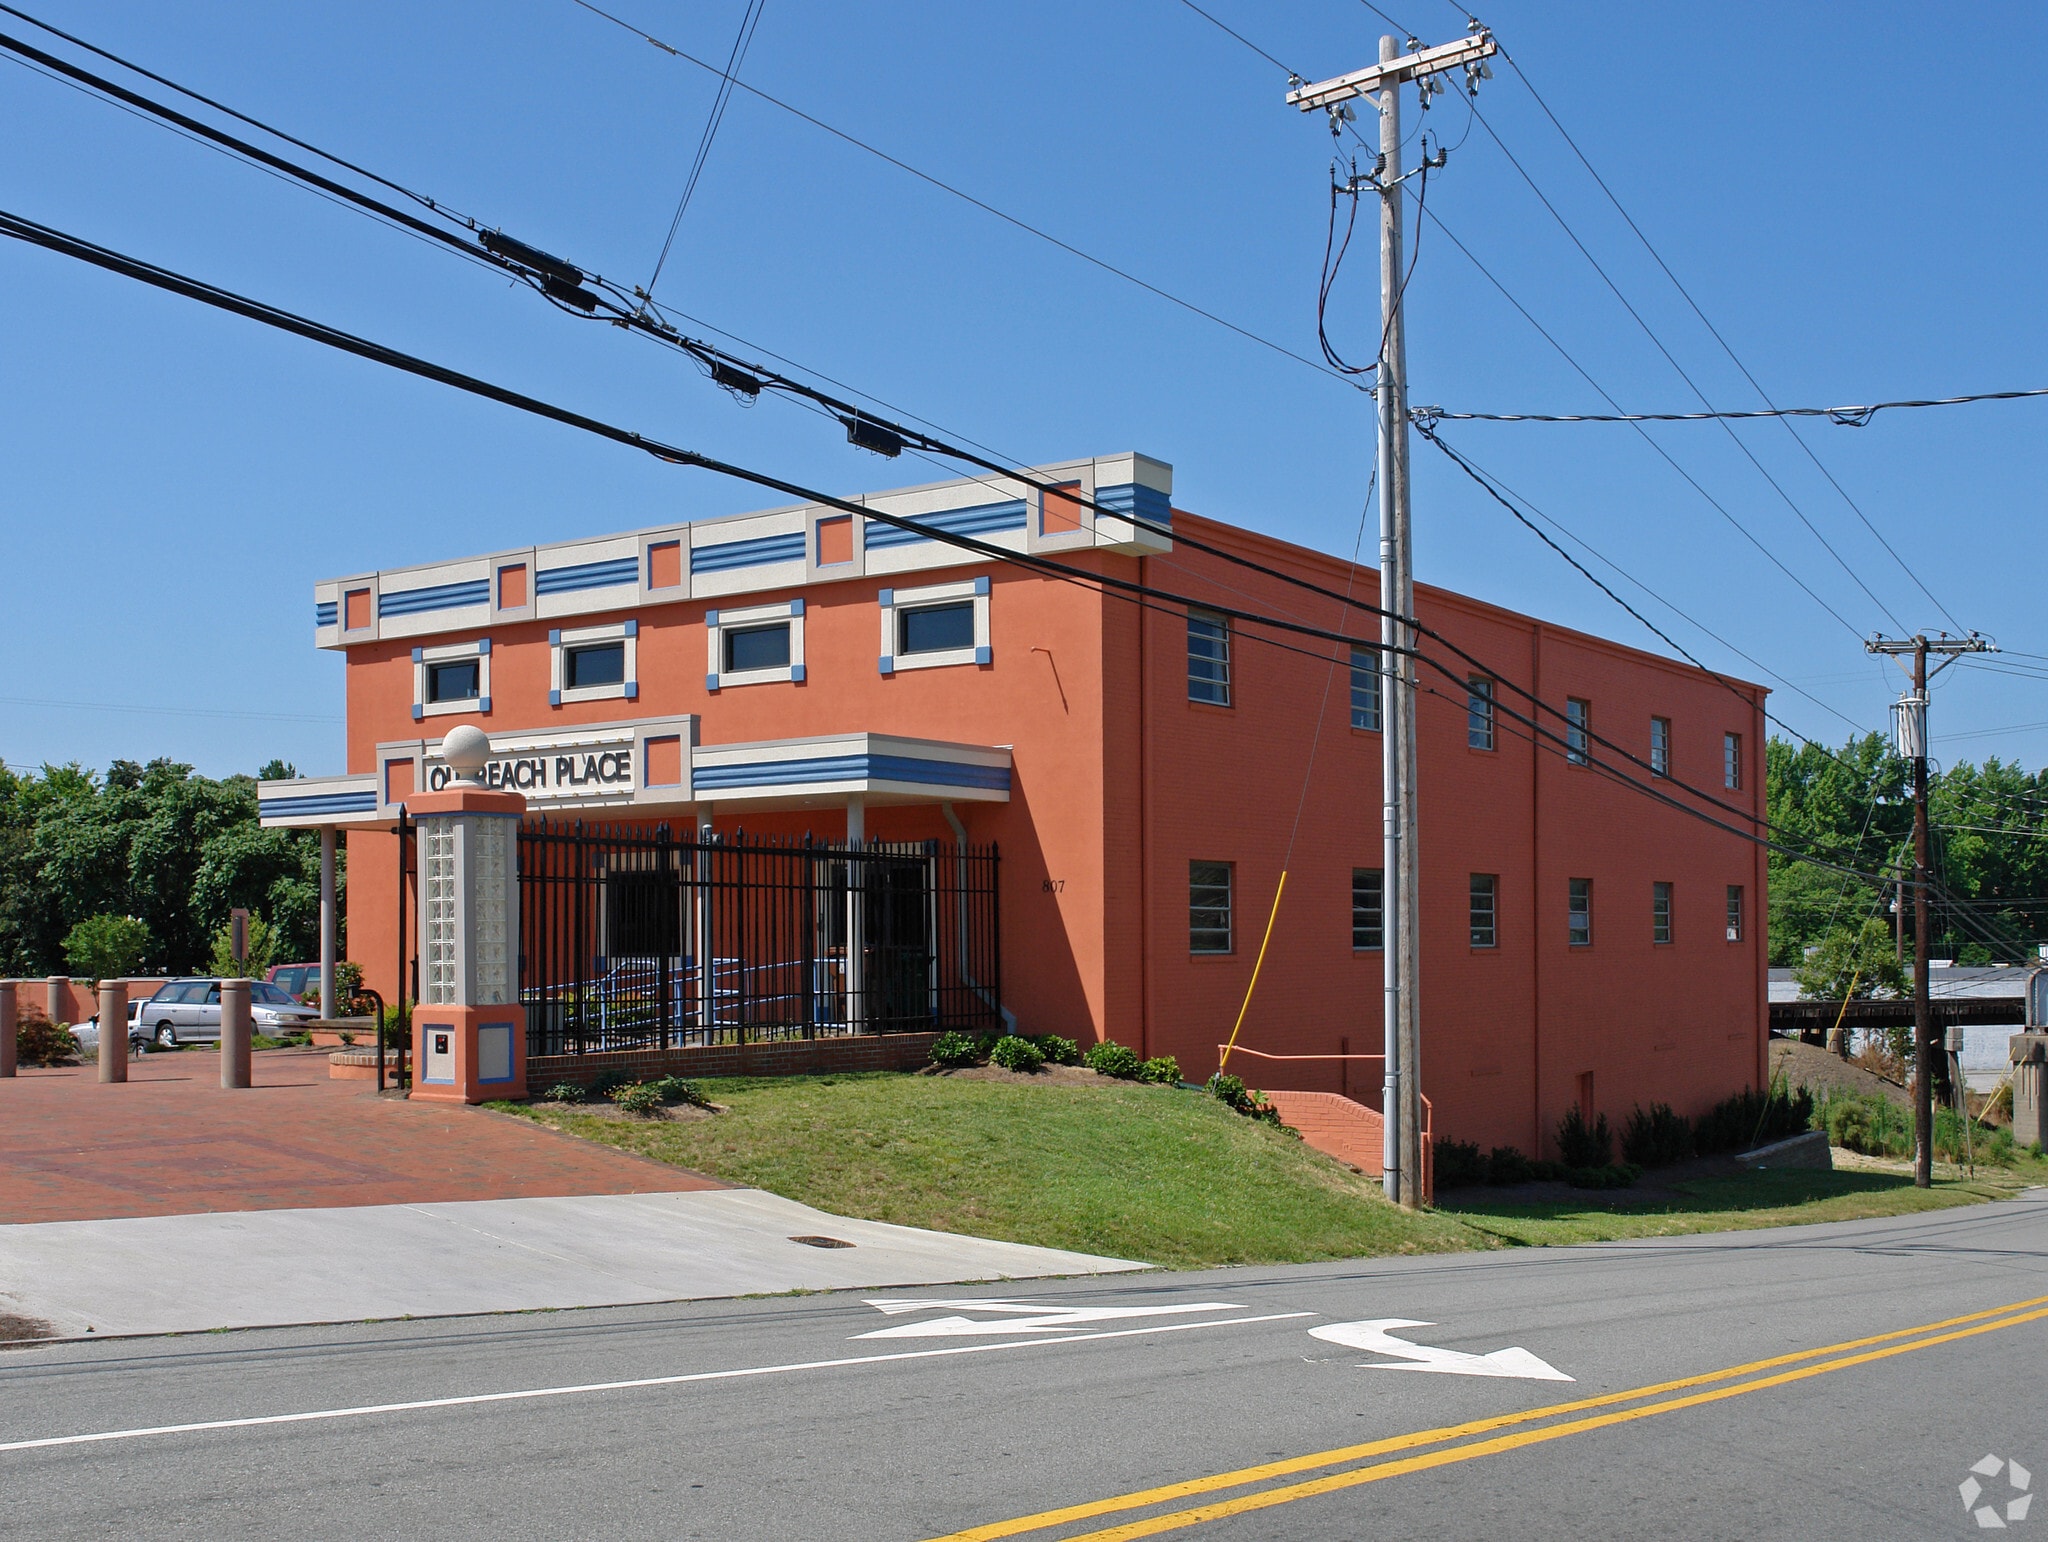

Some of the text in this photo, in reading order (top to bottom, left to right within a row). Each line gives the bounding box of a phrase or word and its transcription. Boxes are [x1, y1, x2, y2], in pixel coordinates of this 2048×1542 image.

[430, 751, 631, 792] OREACH PLACE
[1042, 879, 1065, 893] 807
